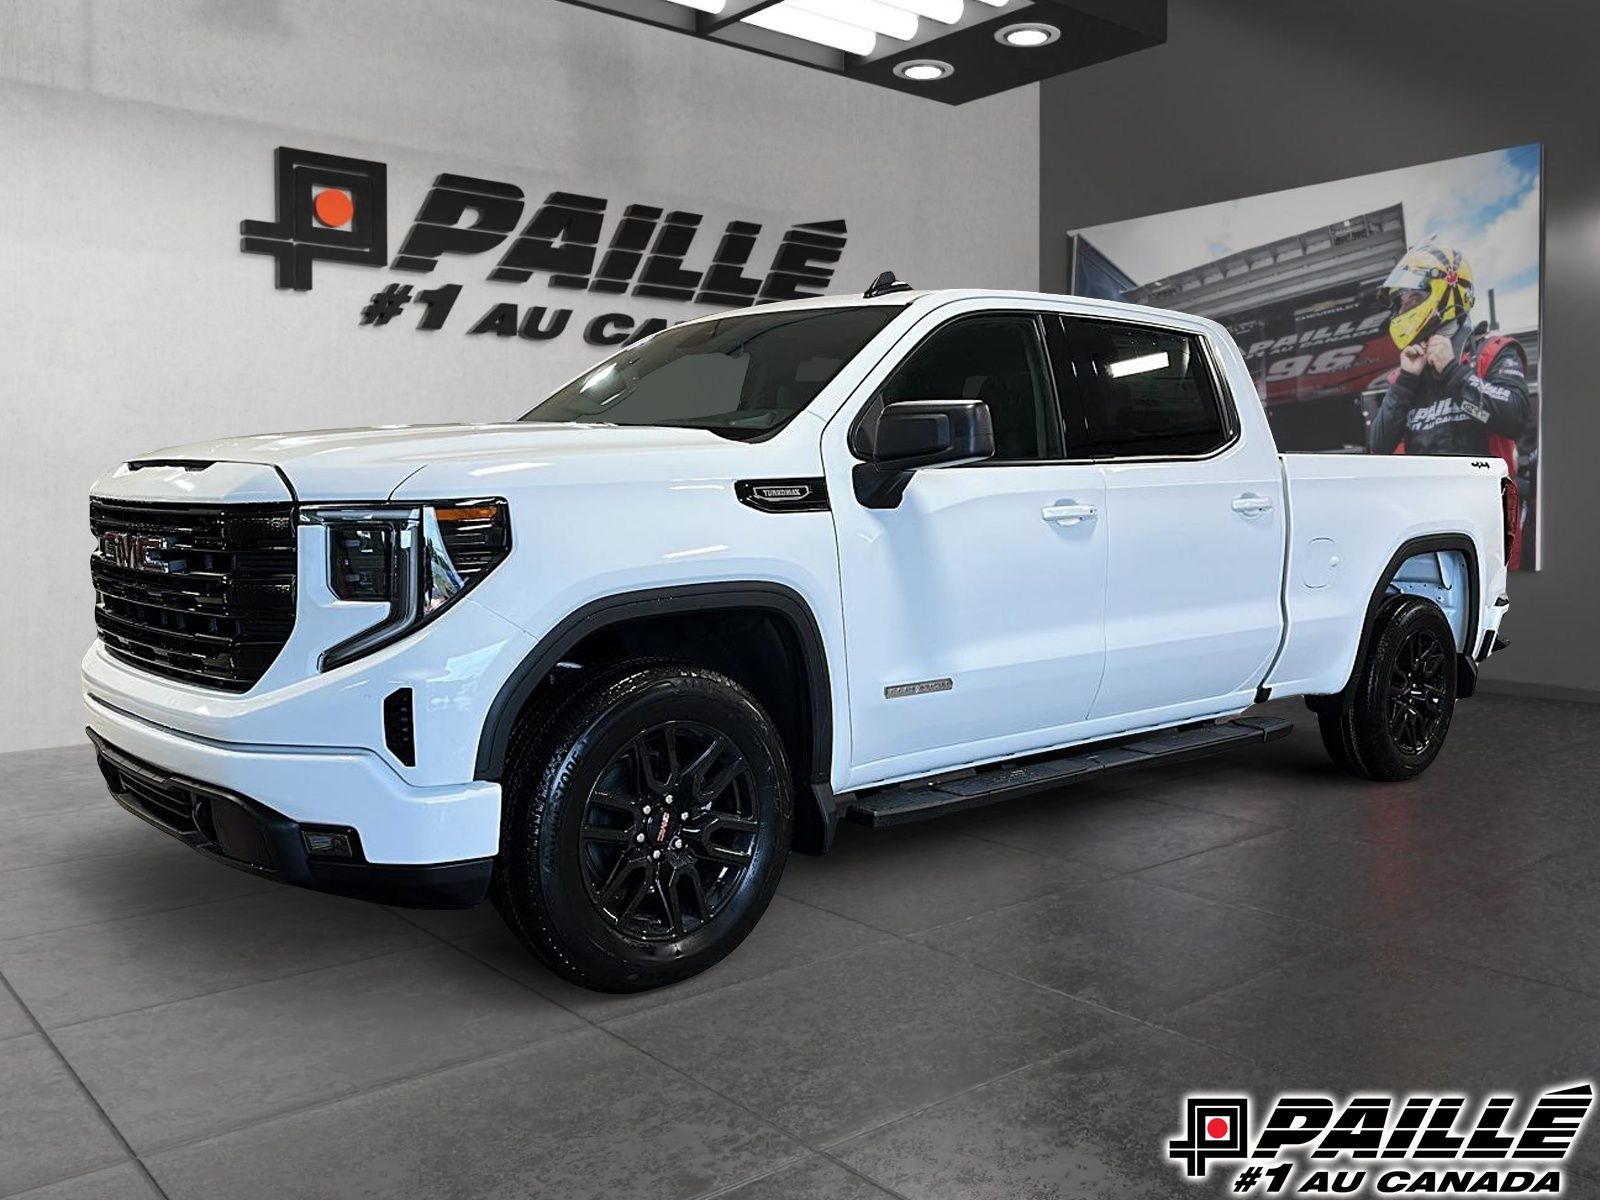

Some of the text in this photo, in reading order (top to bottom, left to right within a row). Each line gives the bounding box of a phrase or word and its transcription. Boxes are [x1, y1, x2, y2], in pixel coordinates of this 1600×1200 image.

[389, 172, 848, 306] PAILLÉ
[358, 284, 463, 331] #1
[466, 302, 574, 341] AU
[1266, 344, 1365, 382] 96
